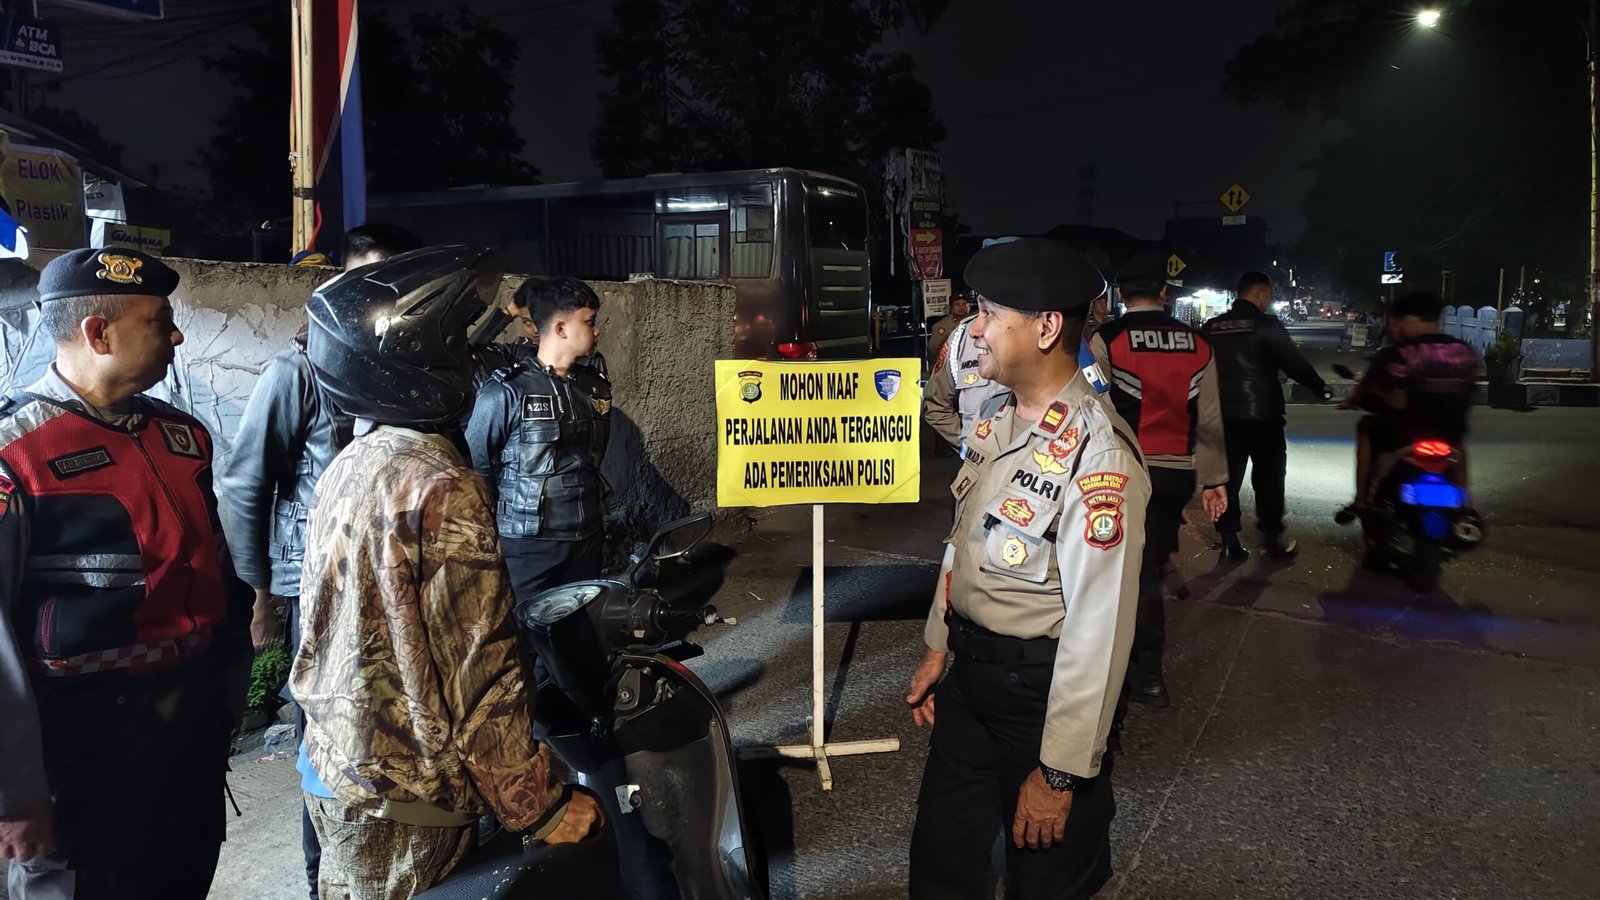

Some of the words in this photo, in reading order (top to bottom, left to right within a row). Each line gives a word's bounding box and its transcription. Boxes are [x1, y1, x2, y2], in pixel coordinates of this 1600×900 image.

[17, 24, 48, 41] ATM
[29, 40, 57, 57] BCA
[18, 158, 60, 182] ELOK
[16, 199, 70, 222] Plastik
[1130, 329, 1195, 351] POLISI
[780, 373, 823, 399] MOHON
[827, 372, 858, 399] MAAF
[527, 403, 548, 412] AZIS
[726, 418, 802, 445] PERJALANAN
[806, 417, 838, 443] ANDA
[841, 415, 911, 442] TERGANGGU
[745, 463, 767, 488] ADA
[772, 461, 853, 488] PEMERIKSAAN
[857, 460, 894, 486] POLISI
[1011, 469, 1061, 502] POLRI
[1088, 494, 1106, 504] METRO
